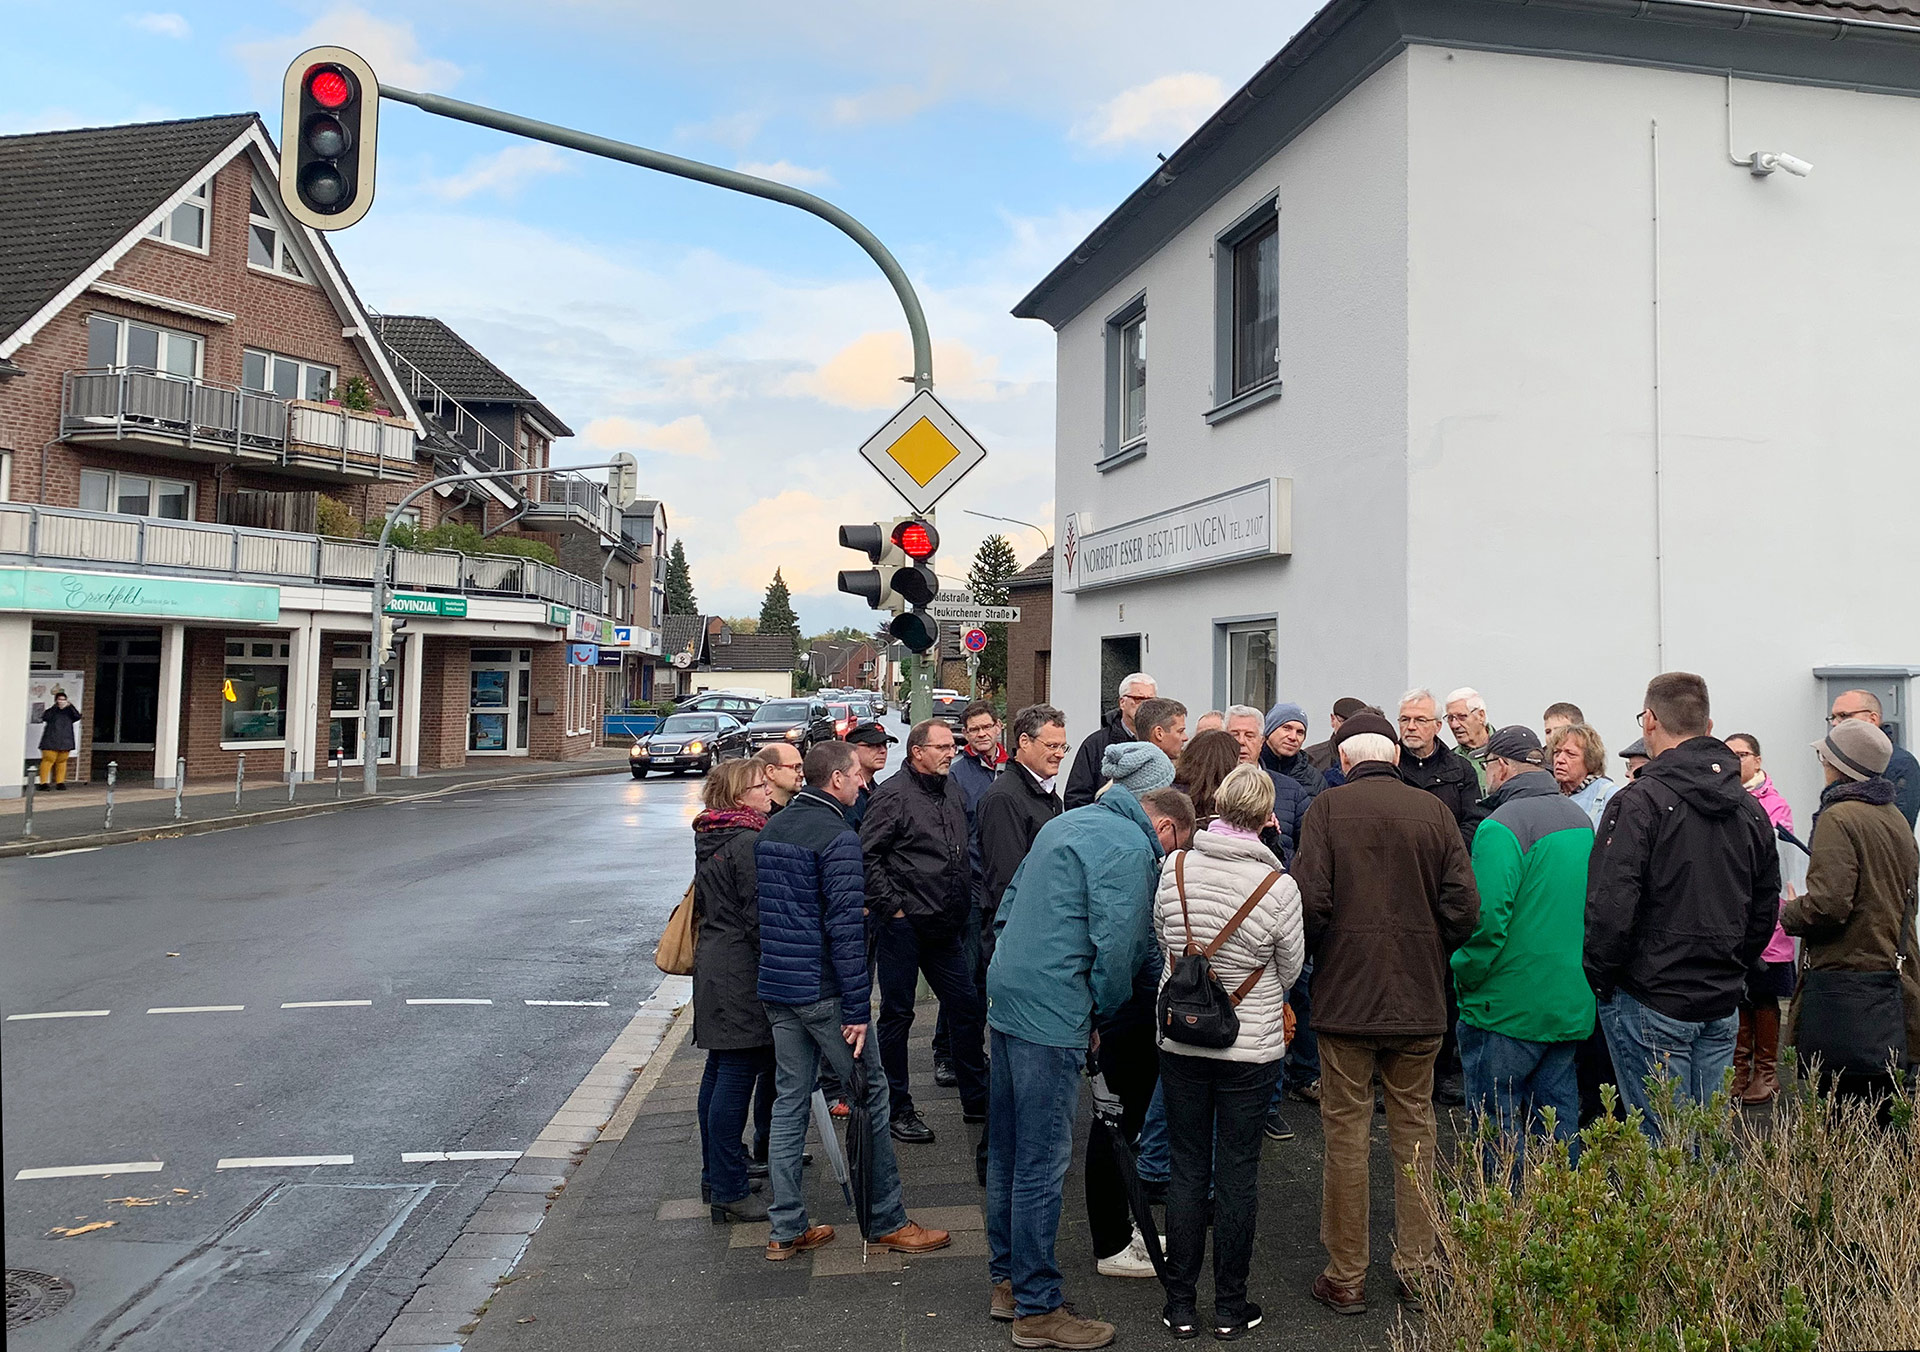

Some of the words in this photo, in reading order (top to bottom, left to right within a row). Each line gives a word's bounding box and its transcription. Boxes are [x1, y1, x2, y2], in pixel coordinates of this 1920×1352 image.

[1083, 543, 1119, 573] NORBERT
[1120, 536, 1143, 566] ESSER
[1147, 513, 1227, 560] BESTATTUNGEN
[1229, 521, 1244, 541] TEL.
[1246, 515, 1263, 538] 2107
[934, 592, 970, 603] aldstraße
[933, 606, 981, 618] eukirchener
[985, 608, 1010, 619] Straße
